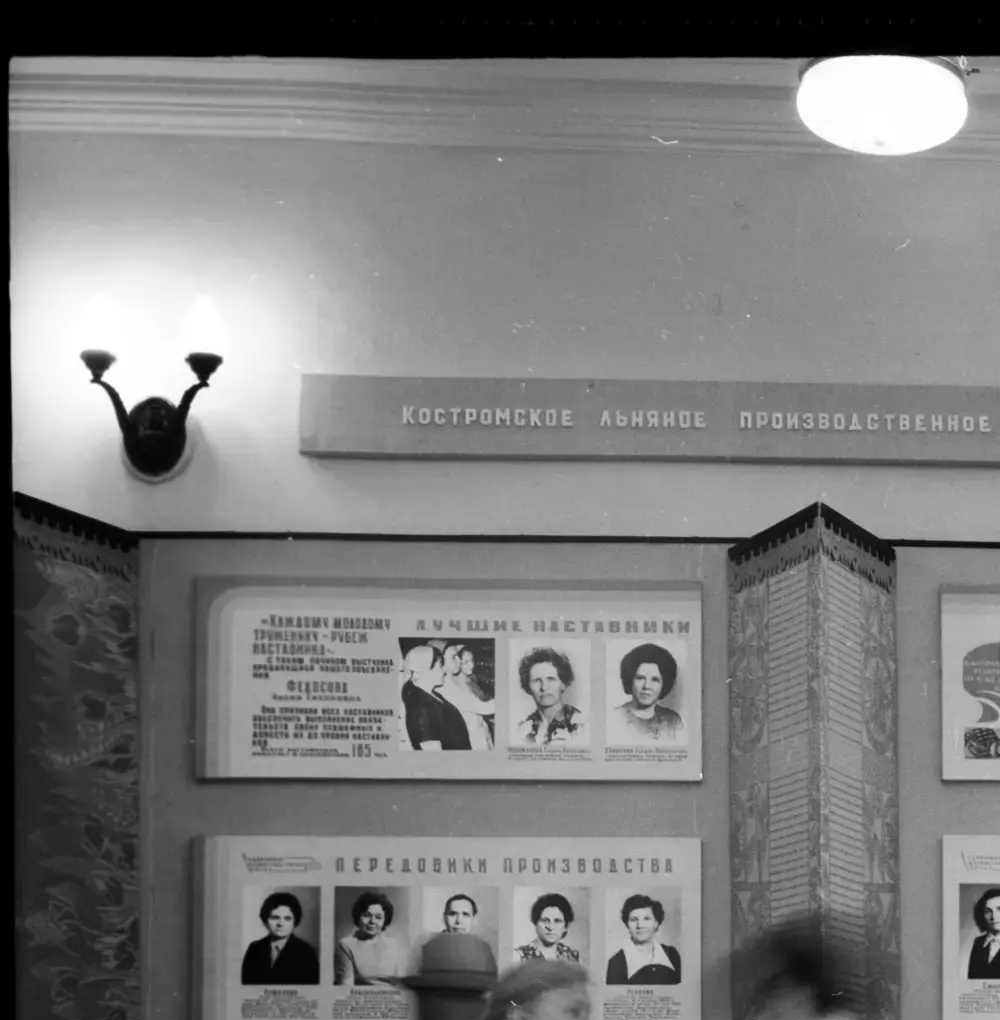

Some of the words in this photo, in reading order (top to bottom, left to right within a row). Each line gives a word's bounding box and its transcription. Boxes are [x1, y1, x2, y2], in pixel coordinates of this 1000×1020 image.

[401, 405, 574, 426] КОСТРОМСКОЕ
[600, 410, 707, 428] ЛЬНЯНОЕ
[739, 411, 992, 433] ПРОИЗВОДСТВЕННОЕ
[333, 617, 391, 632] МОЛОДОМУ
[416, 619, 523, 633] ЛУЧШИЕ
[533, 620, 691, 634] НАСТАВНИКИ
[331, 631, 368, 644] РУБЕЖ
[335, 856, 488, 873] ПЕРЕДОВИКИ
[503, 857, 675, 874] ПРОИЗВОДСТВА
